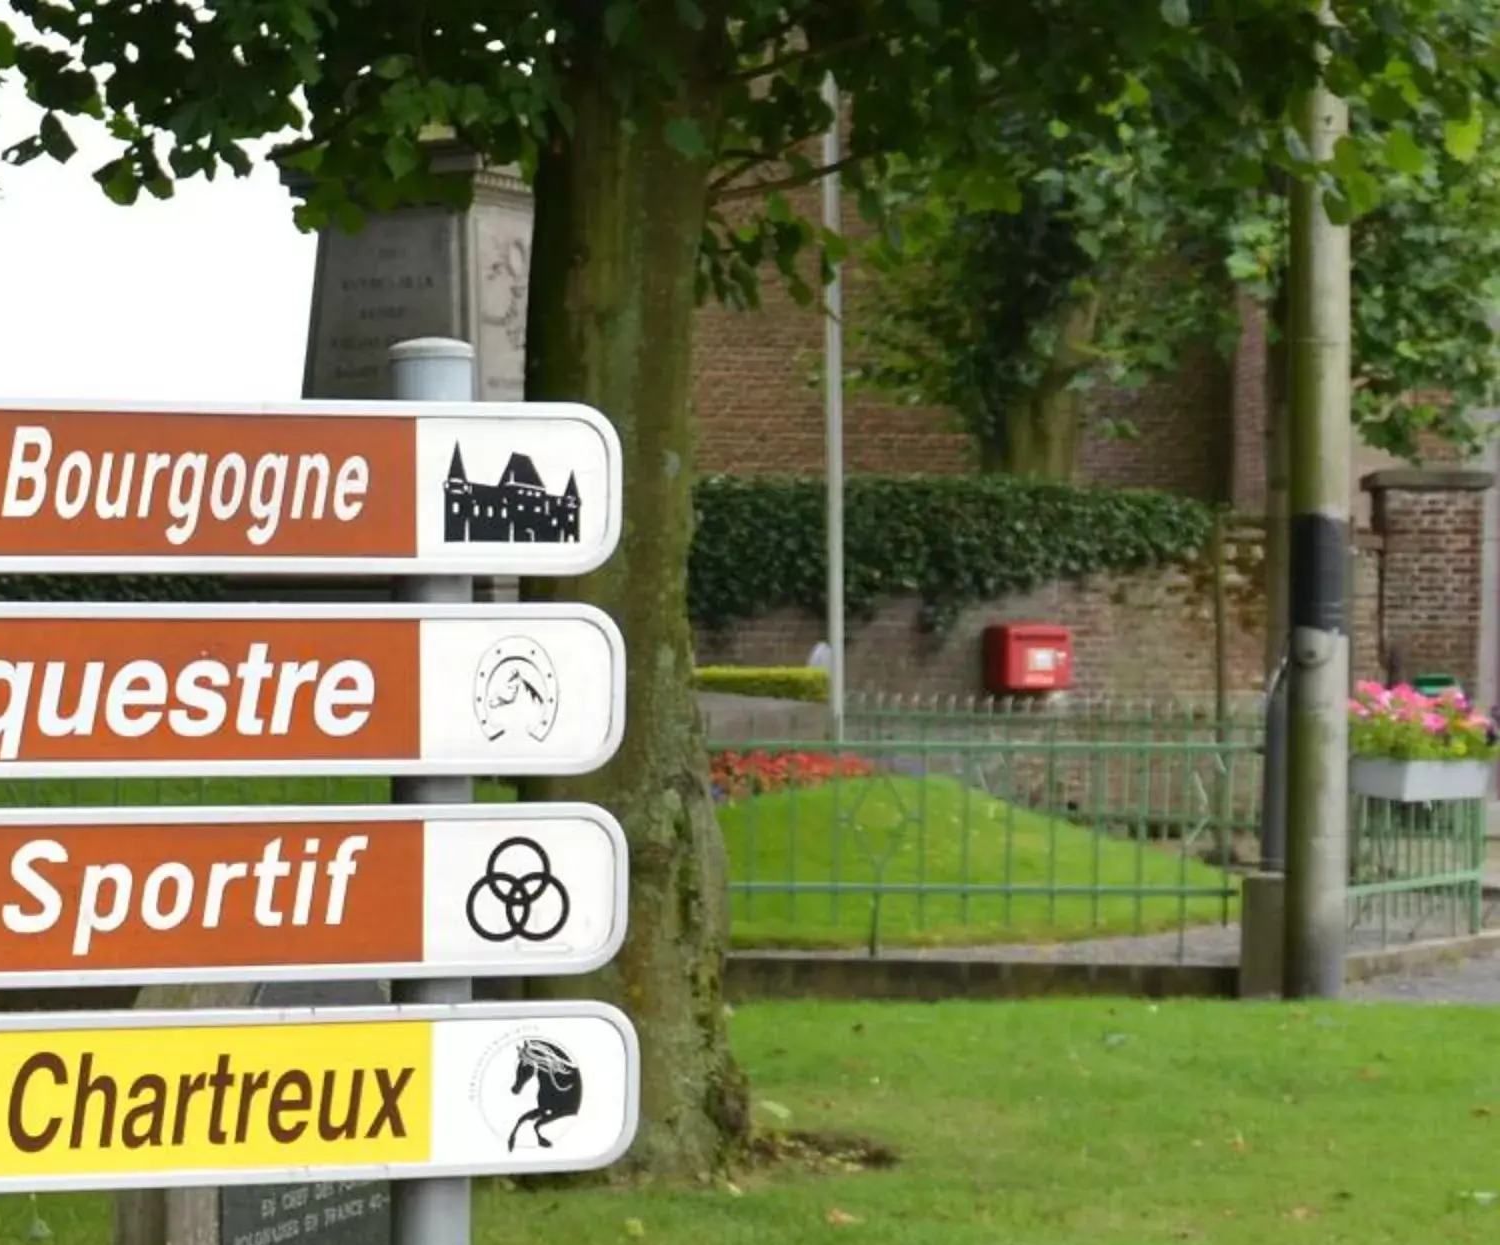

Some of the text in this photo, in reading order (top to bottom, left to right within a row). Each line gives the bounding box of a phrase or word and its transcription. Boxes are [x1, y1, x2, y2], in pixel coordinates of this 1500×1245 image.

[0, 425, 370, 546] Bourgogne
[1, 834, 370, 957] Sportif
[7, 1050, 415, 1154] Chartreux
